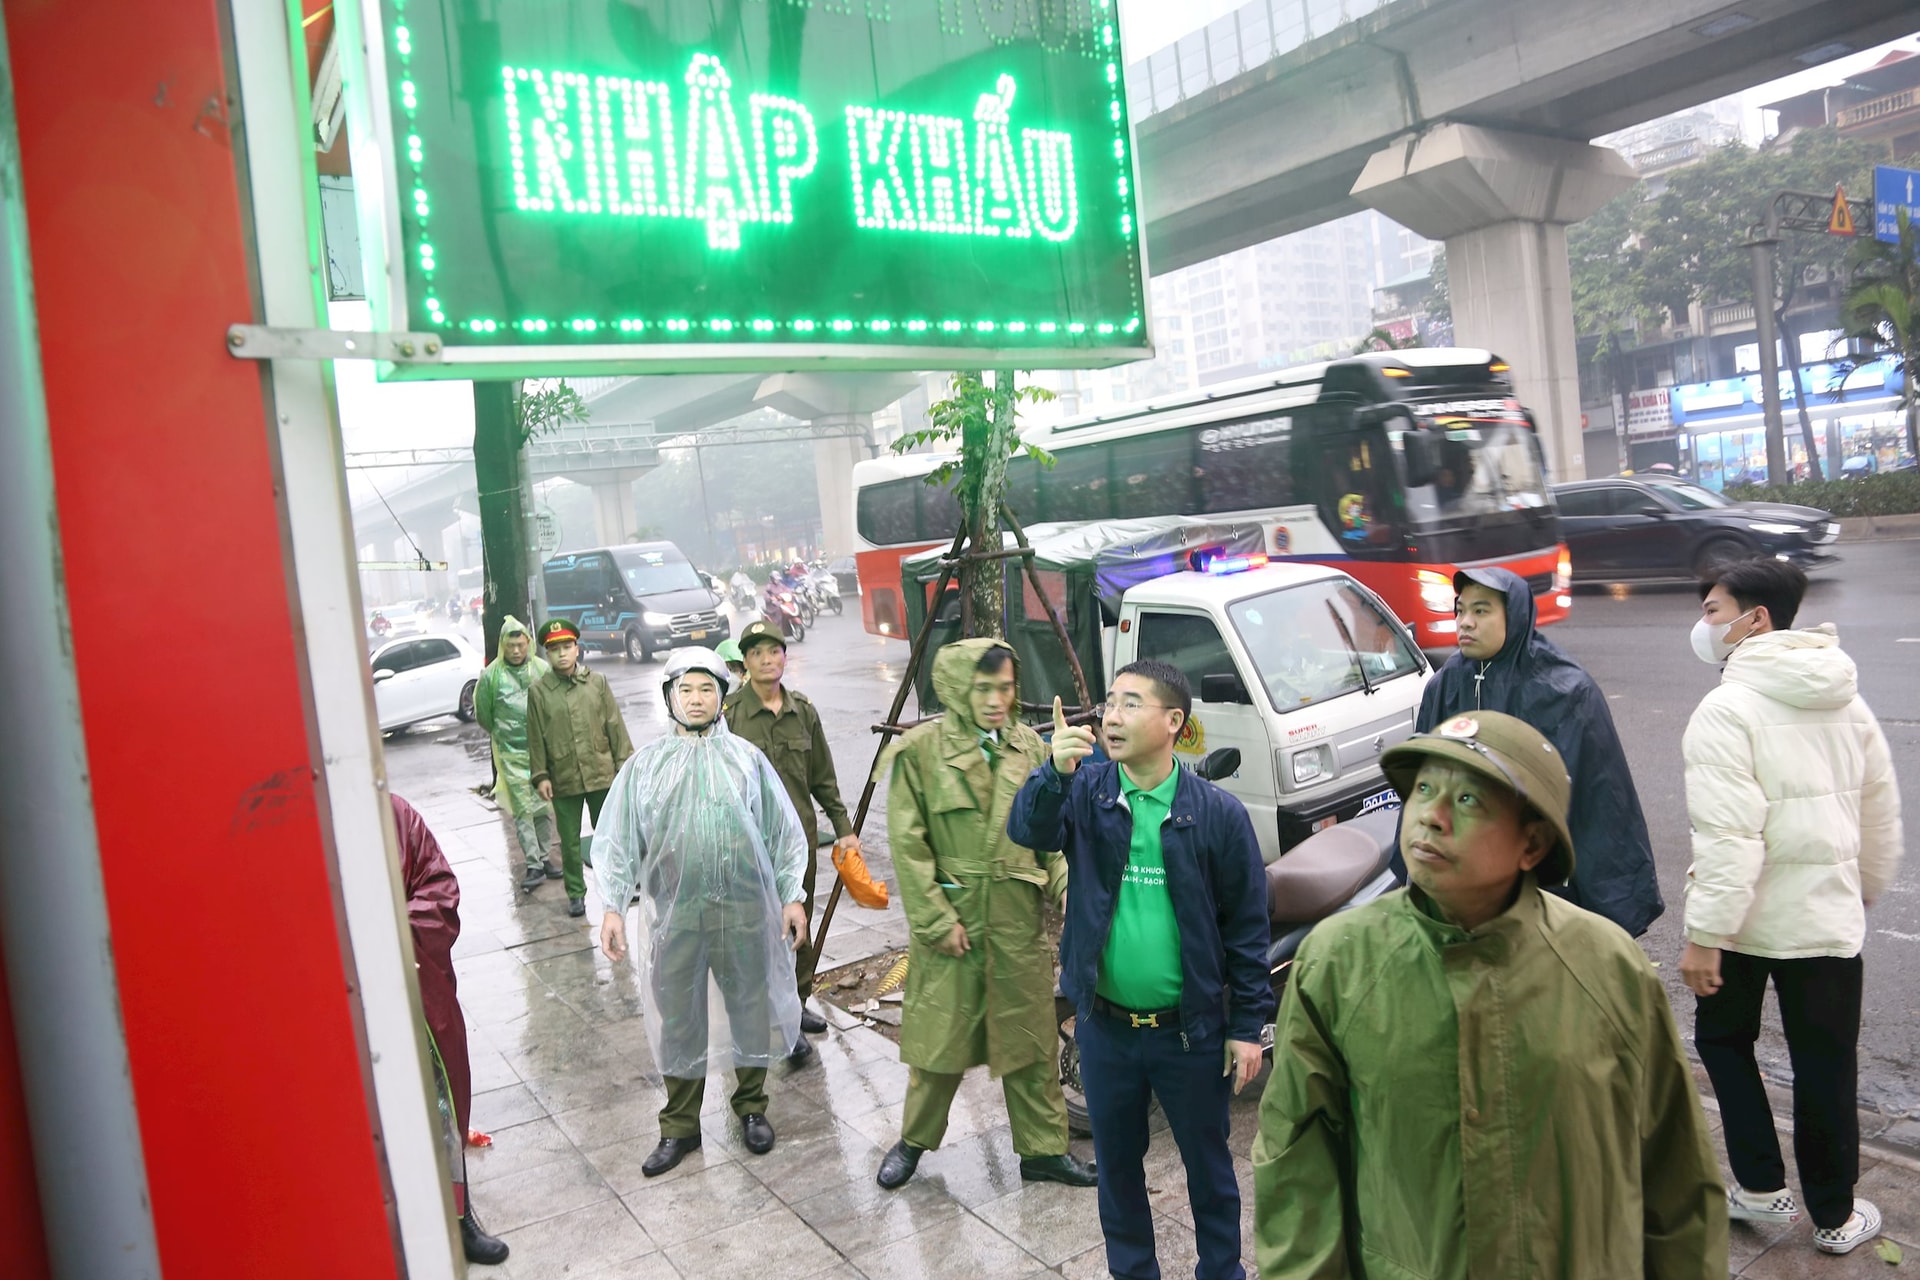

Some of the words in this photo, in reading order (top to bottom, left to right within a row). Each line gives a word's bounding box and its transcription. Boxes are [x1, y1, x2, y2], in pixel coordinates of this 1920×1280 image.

[501, 52, 819, 251] NHẬP
[844, 73, 1079, 243] KHẨU
[1143, 877, 1164, 886] SẠCH
